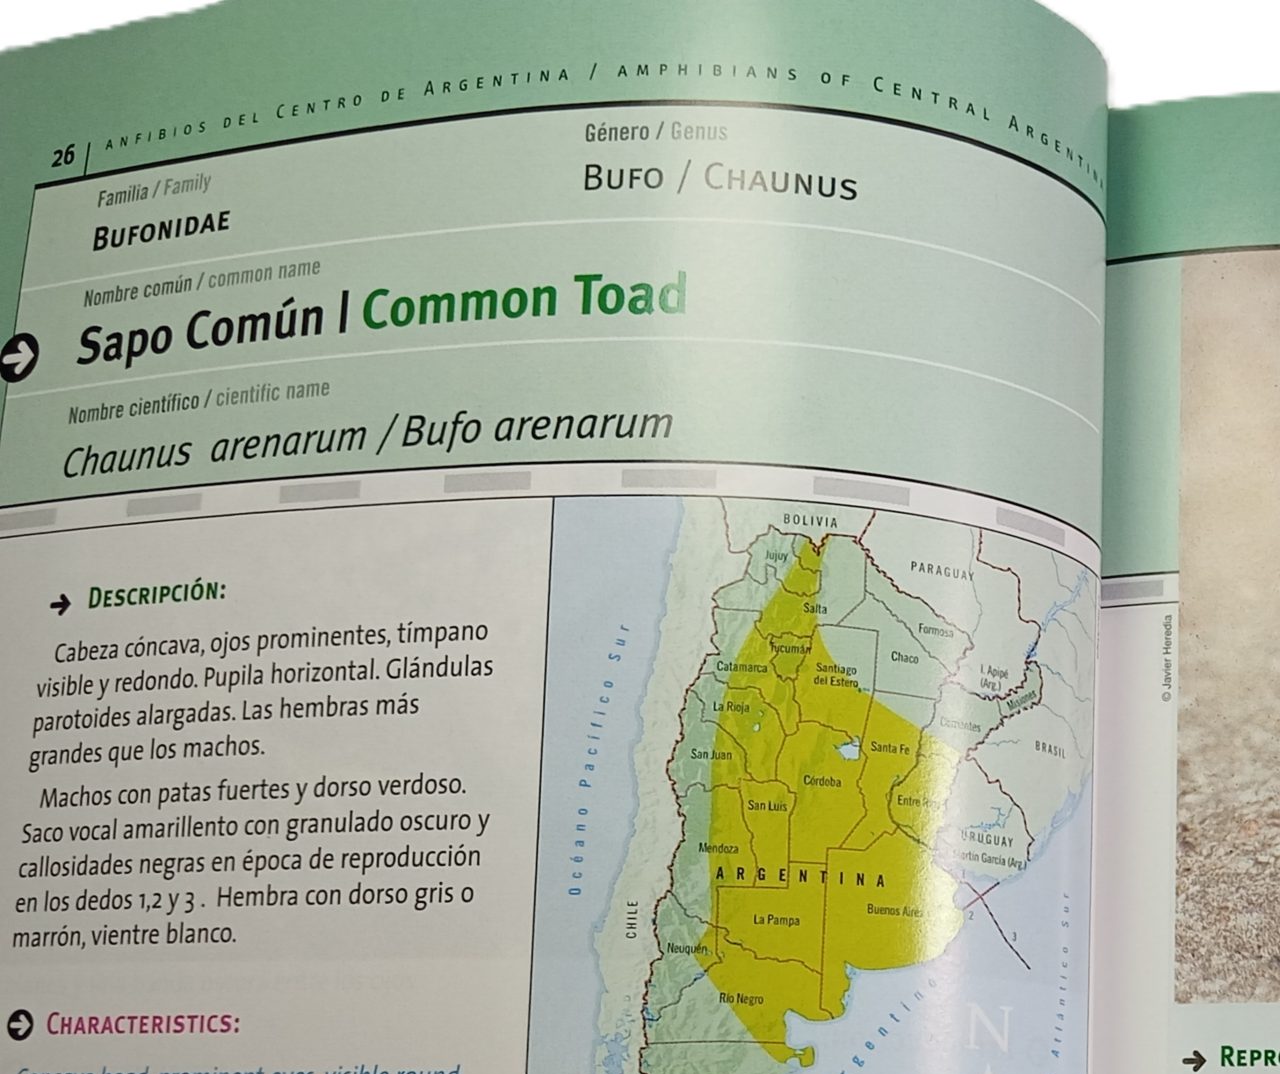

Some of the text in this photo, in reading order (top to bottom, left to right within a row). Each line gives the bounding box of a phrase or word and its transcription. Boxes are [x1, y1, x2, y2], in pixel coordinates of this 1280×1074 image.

[50, 143, 76, 168] 26
[423, 68, 569, 97] ARGENTINA
[873, 76, 990, 121] CENTRAL
[585, 121, 650, 143] Género
[670, 120, 728, 141] Genus
[584, 163, 663, 191] BUFO
[704, 163, 858, 201] CHAUNUS
[97, 183, 149, 209] Familia
[163, 172, 212, 196] Family
[92, 210, 231, 252] BUFONIDAE
[83, 284, 139, 308] Nombre
[143, 274, 193, 299] común
[208, 266, 273, 289] common
[278, 260, 321, 280] name
[76, 271, 687, 370] Sapo Común Common Toad
[68, 402, 125, 425] Nombre
[129, 392, 200, 417] científico
[215, 383, 281, 407] cientific
[286, 381, 330, 400] name
[63, 441, 193, 479] Chaunus
[210, 426, 367, 463] arenarum
[401, 410, 482, 454] Bufo
[494, 413, 672, 442] arenarum
[783, 514, 837, 528] BOLIVIA
[766, 550, 788, 562] Jujuy
[911, 561, 975, 581] PARAGUAY
[88, 576, 226, 610] DESCRIPCIÓN:
[803, 603, 827, 614] Salta
[918, 623, 954, 638] Formosa
[1163, 615, 1172, 655] Heredia
[54, 620, 489, 664] Cabeza cóncava, ojos prominentes, tímpano
[770, 643, 811, 654] Tucumán
[891, 651, 919, 664] Chaco
[717, 661, 768, 673] Catamarca
[816, 662, 857, 675] Santiago
[1162, 658, 1172, 689] Javier
[814, 675, 858, 688] del Estero
[713, 701, 750, 714] La Rioja
[691, 750, 732, 760] San Juan
[871, 741, 910, 755] Santa Fe
[1035, 741, 1066, 758] BRASIL
[803, 775, 841, 788] Córdoba
[748, 800, 787, 812] San Luis
[897, 795, 920, 807] Entre
[699, 843, 739, 854] Mendoza
[716, 867, 885, 888] ARGENTINA
[867, 904, 900, 915] Buenos
[626, 901, 637, 938] CHILE
[754, 914, 800, 927] La Pampa
[667, 943, 707, 954] Neuquén
[736, 994, 764, 1006] Negro
[46, 1011, 240, 1036] CHARACTERISTICS:
